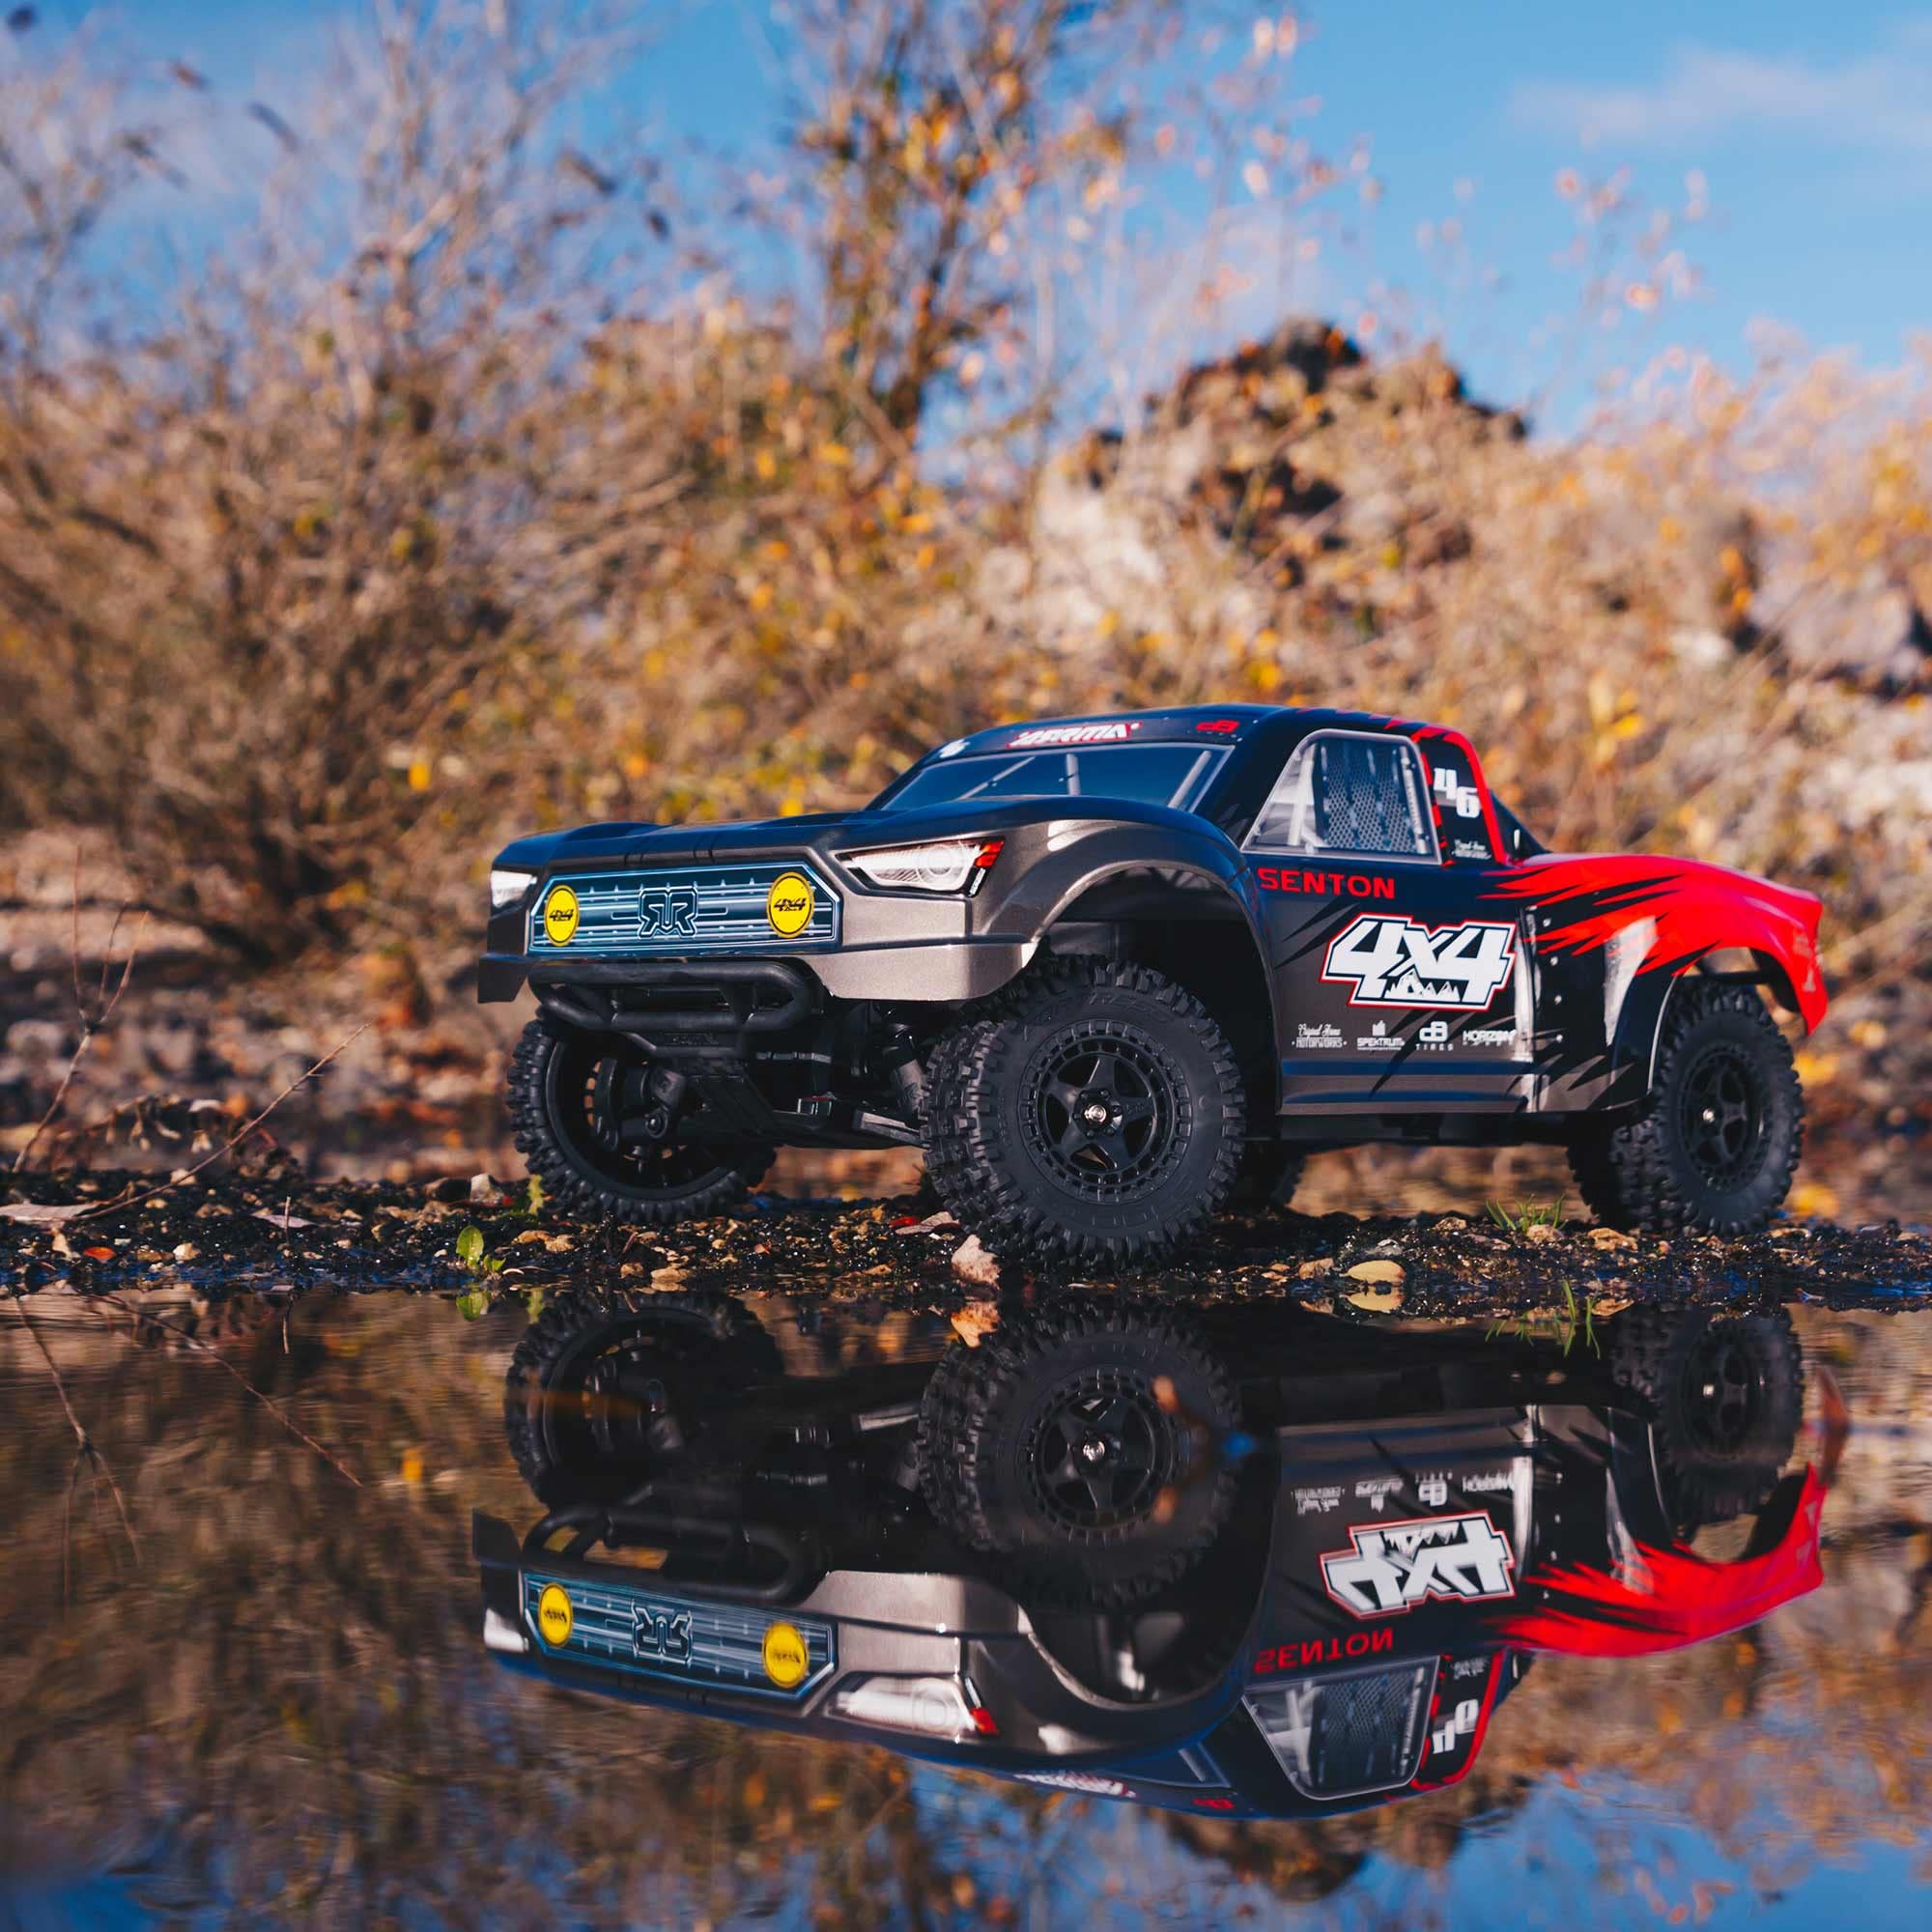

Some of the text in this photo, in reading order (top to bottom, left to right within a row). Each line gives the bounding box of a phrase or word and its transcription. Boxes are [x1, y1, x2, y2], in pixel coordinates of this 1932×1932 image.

[1434, 767, 1480, 818] 46
[1258, 868, 1395, 899] SENTON
[1323, 916, 1512, 1008] 4x4
